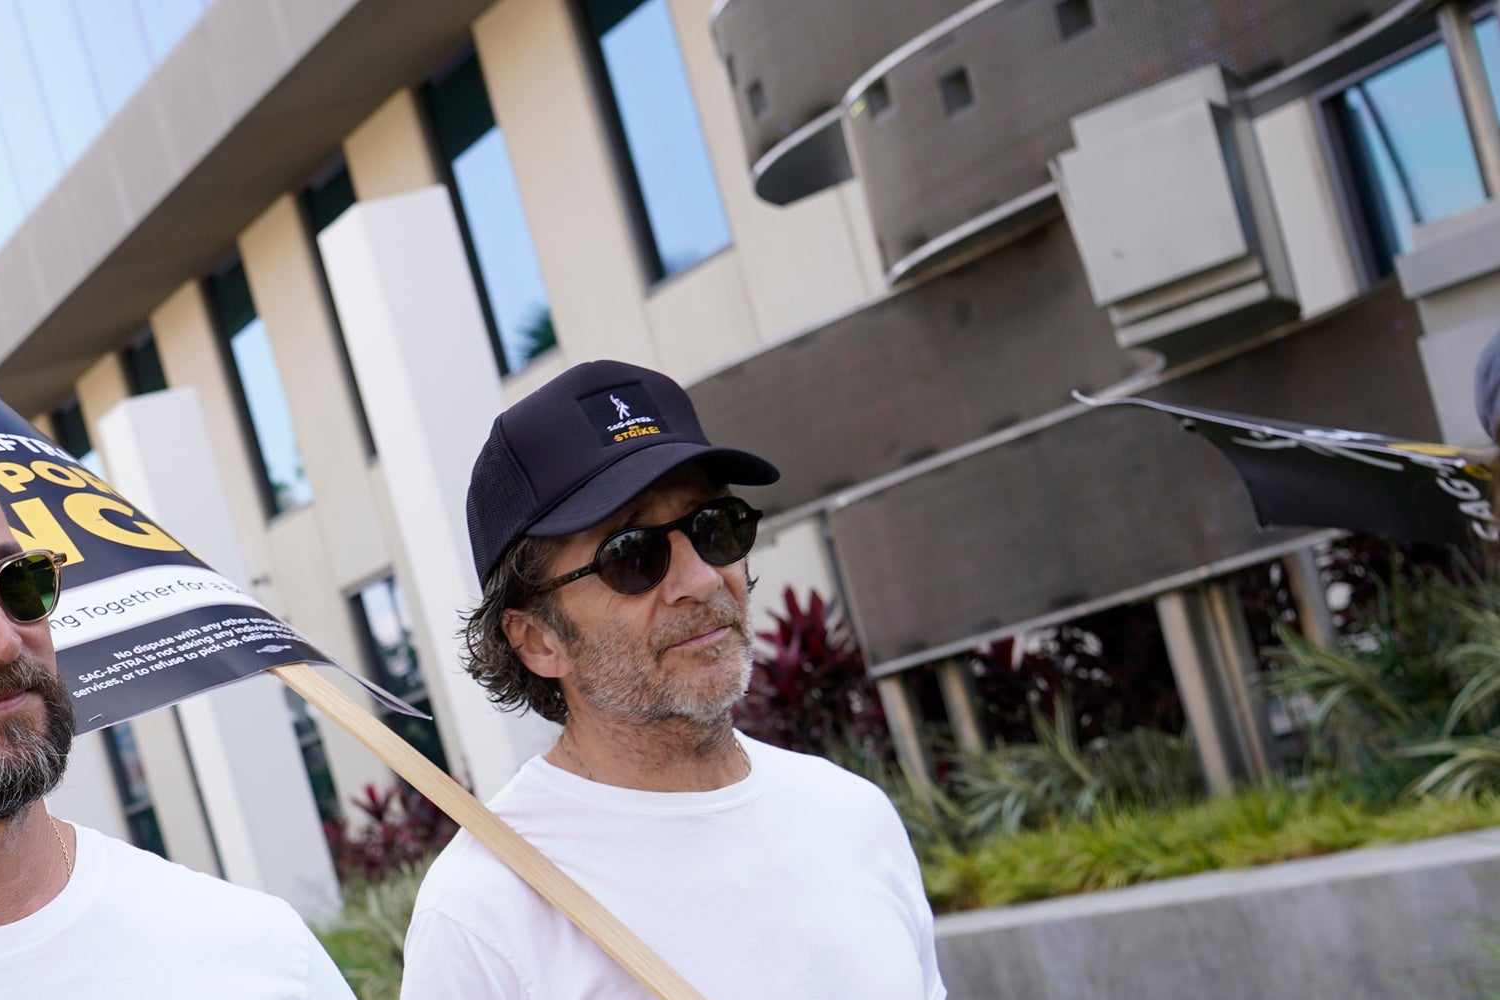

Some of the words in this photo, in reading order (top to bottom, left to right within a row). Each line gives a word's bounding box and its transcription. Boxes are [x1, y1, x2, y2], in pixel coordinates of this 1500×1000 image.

[614, 426, 660, 441] STRIKE!
[76, 584, 177, 618] Together
[177, 580, 207, 590] for
[78, 657, 146, 683] SAG-AFTRA
[142, 654, 157, 662] is
[156, 647, 177, 658] not
[176, 636, 215, 652] asking
[213, 629, 234, 639] any
[113, 650, 133, 660] No
[133, 637, 175, 654] dispute
[174, 628, 201, 641] with
[200, 622, 222, 632] any
[221, 618, 249, 626] other
[73, 677, 123, 698] services,
[122, 672, 135, 681] or
[134, 667, 149, 676] to
[149, 656, 185, 671] refuse
[183, 652, 198, 660] to
[198, 644, 224, 657] pick
[222, 638, 243, 647] up,
